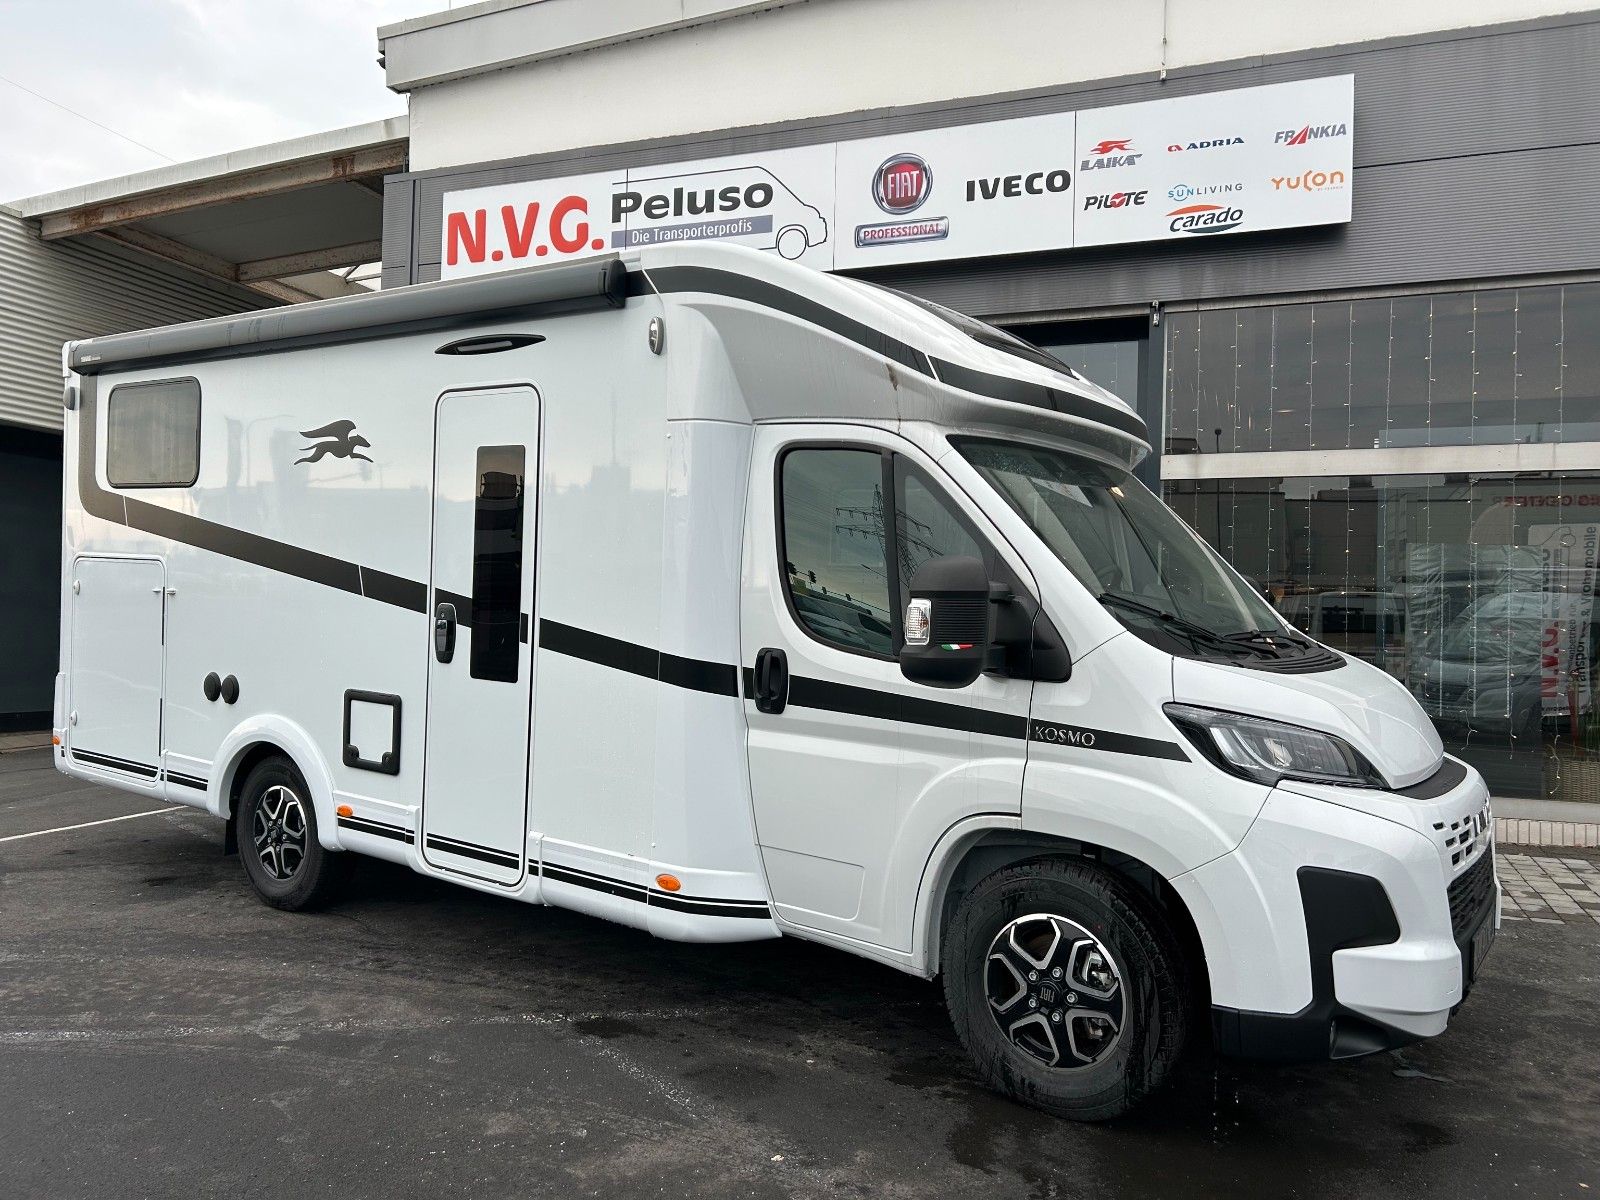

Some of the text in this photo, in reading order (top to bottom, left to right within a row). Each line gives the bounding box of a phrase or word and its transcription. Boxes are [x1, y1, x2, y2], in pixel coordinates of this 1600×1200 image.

[1186, 137, 1245, 151] ADRIA
[1274, 123, 1347, 146] FRANKIA
[1080, 153, 1143, 172] LAIKA
[886, 169, 920, 200] FIAT
[966, 169, 1072, 202] IVECO
[611, 182, 774, 224] Peluso
[447, 195, 605, 266] N.V.G.
[632, 220, 752, 244] Die Transporterprofis
[863, 223, 941, 241] PROFESSIONAL
[1035, 726, 1096, 747] KOSMO
